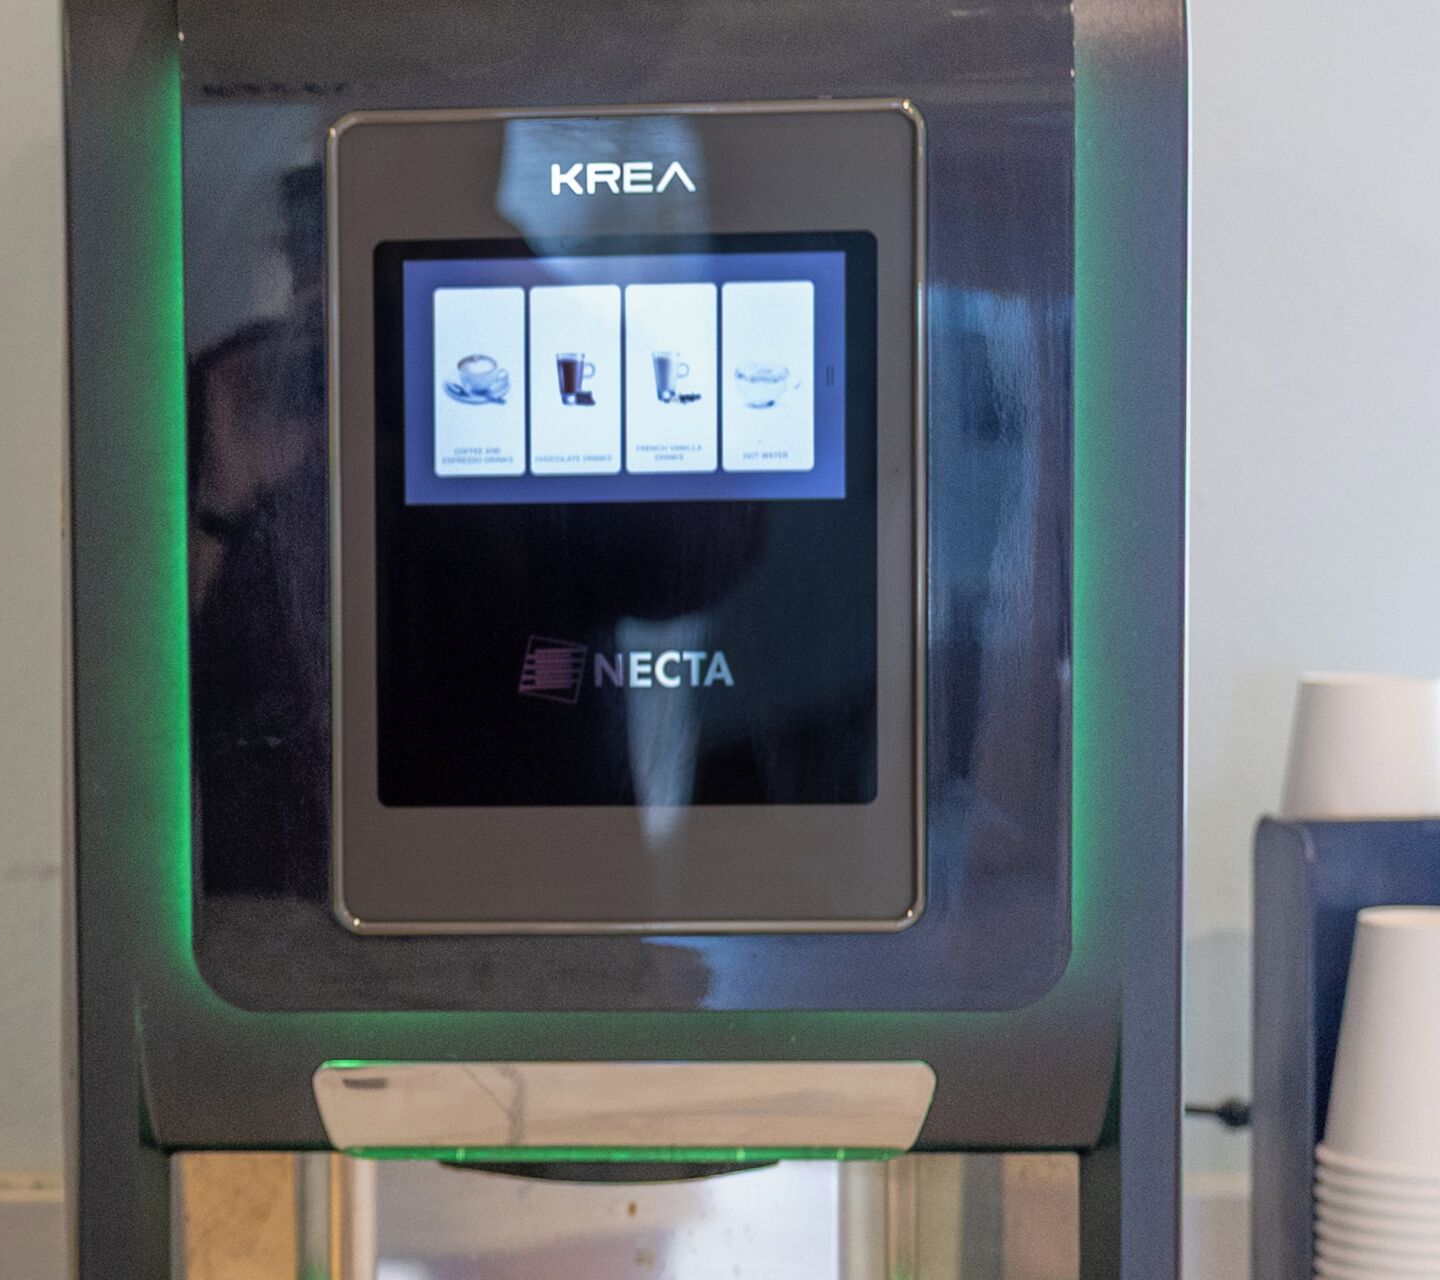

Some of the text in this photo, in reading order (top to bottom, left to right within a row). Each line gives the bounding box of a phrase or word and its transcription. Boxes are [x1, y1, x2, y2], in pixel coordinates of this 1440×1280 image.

[551, 161, 696, 195] KREA
[762, 451, 789, 460] WATER
[593, 651, 735, 689] NECTA
